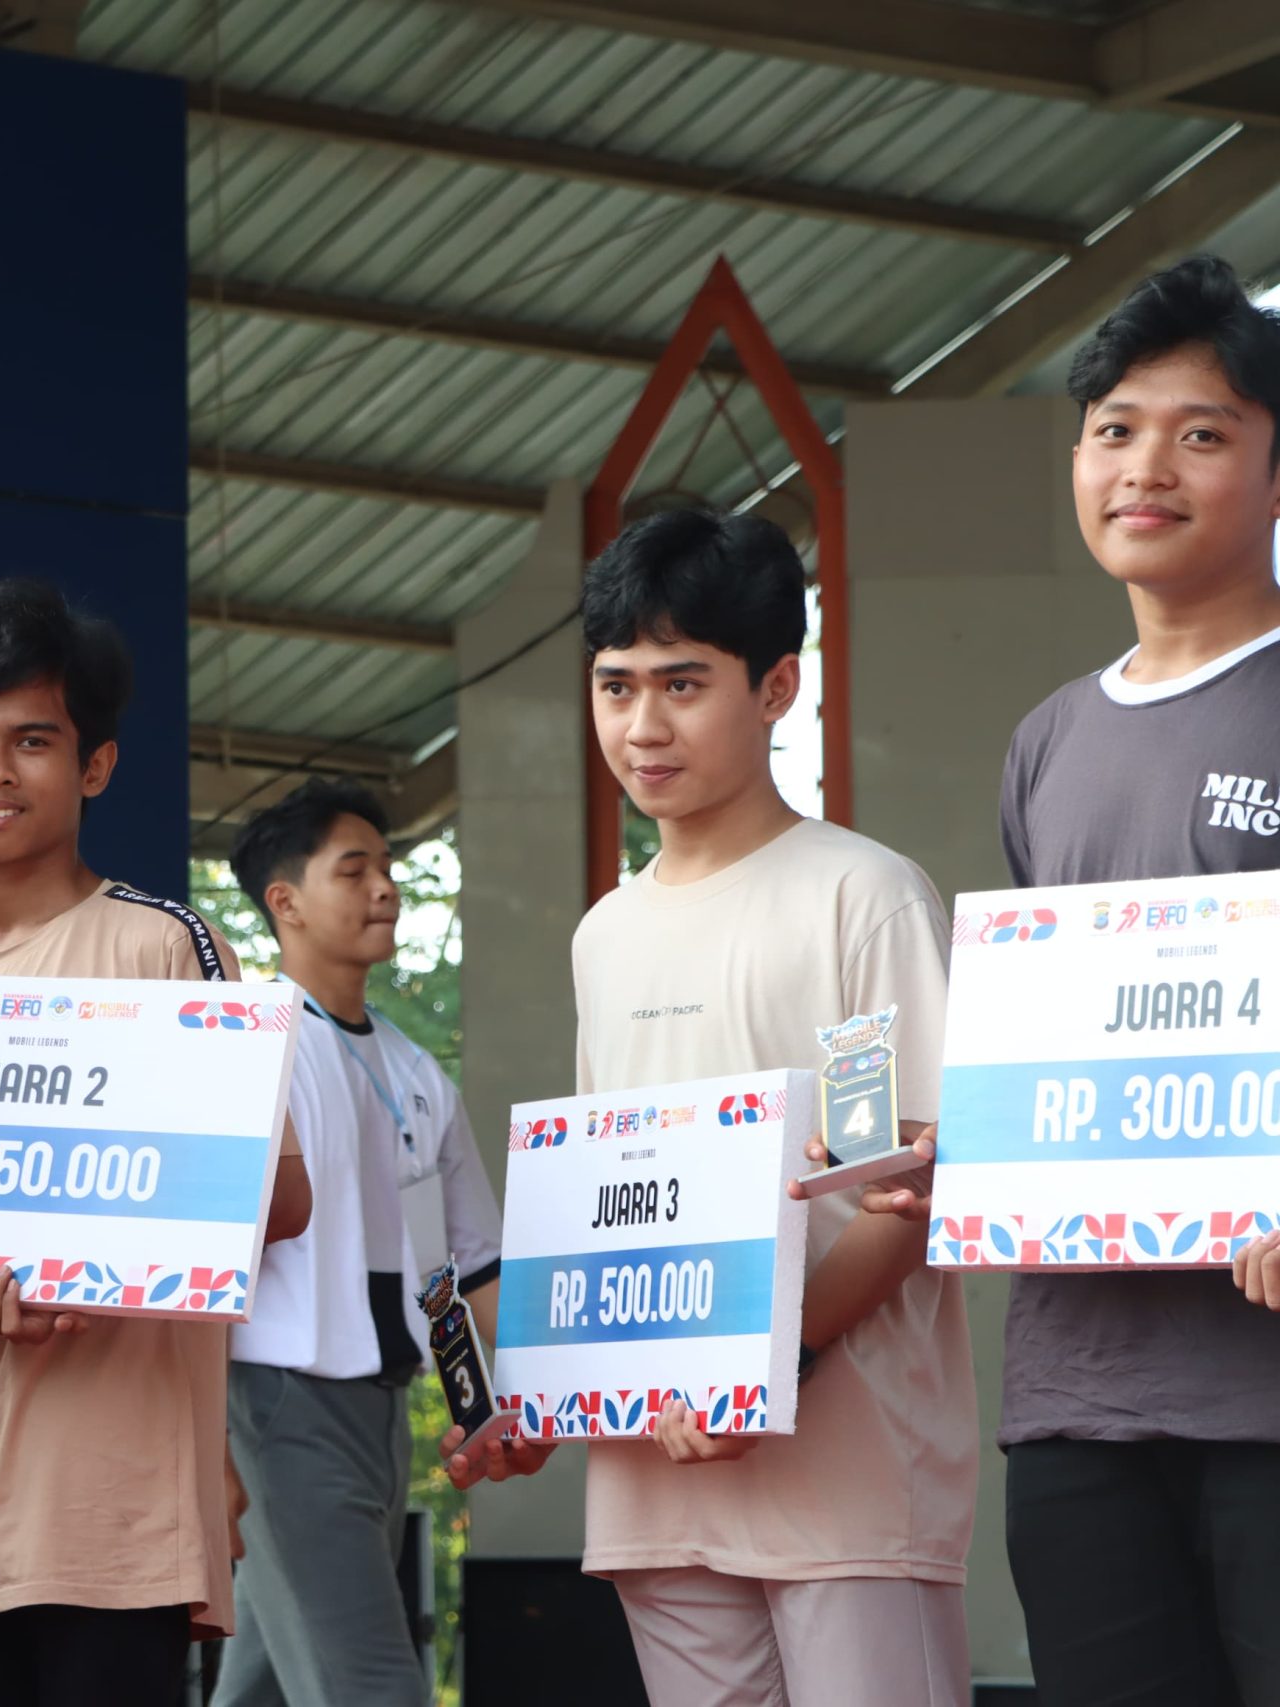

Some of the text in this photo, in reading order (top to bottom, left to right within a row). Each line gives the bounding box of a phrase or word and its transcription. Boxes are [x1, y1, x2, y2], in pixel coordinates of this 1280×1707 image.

[1201, 773, 1280, 811] MIL
[1208, 801, 1280, 836] INC
[175, 908, 217, 967] ARMANI
[1146, 905, 1187, 931] EXPO
[0, 998, 42, 1020] EXPO
[1104, 978, 1261, 1033] JUARA 4
[8, 1036, 69, 1048] MOBILE LEGENDS
[83, 1066, 109, 1107] 2
[616, 1112, 640, 1136] EXPO
[843, 1099, 875, 1137] 4
[1032, 1077, 1102, 1143] RP.
[591, 1177, 679, 1229] JUARA 3
[550, 1259, 714, 1329] RP. 500.000
[455, 1365, 475, 1409] 3
